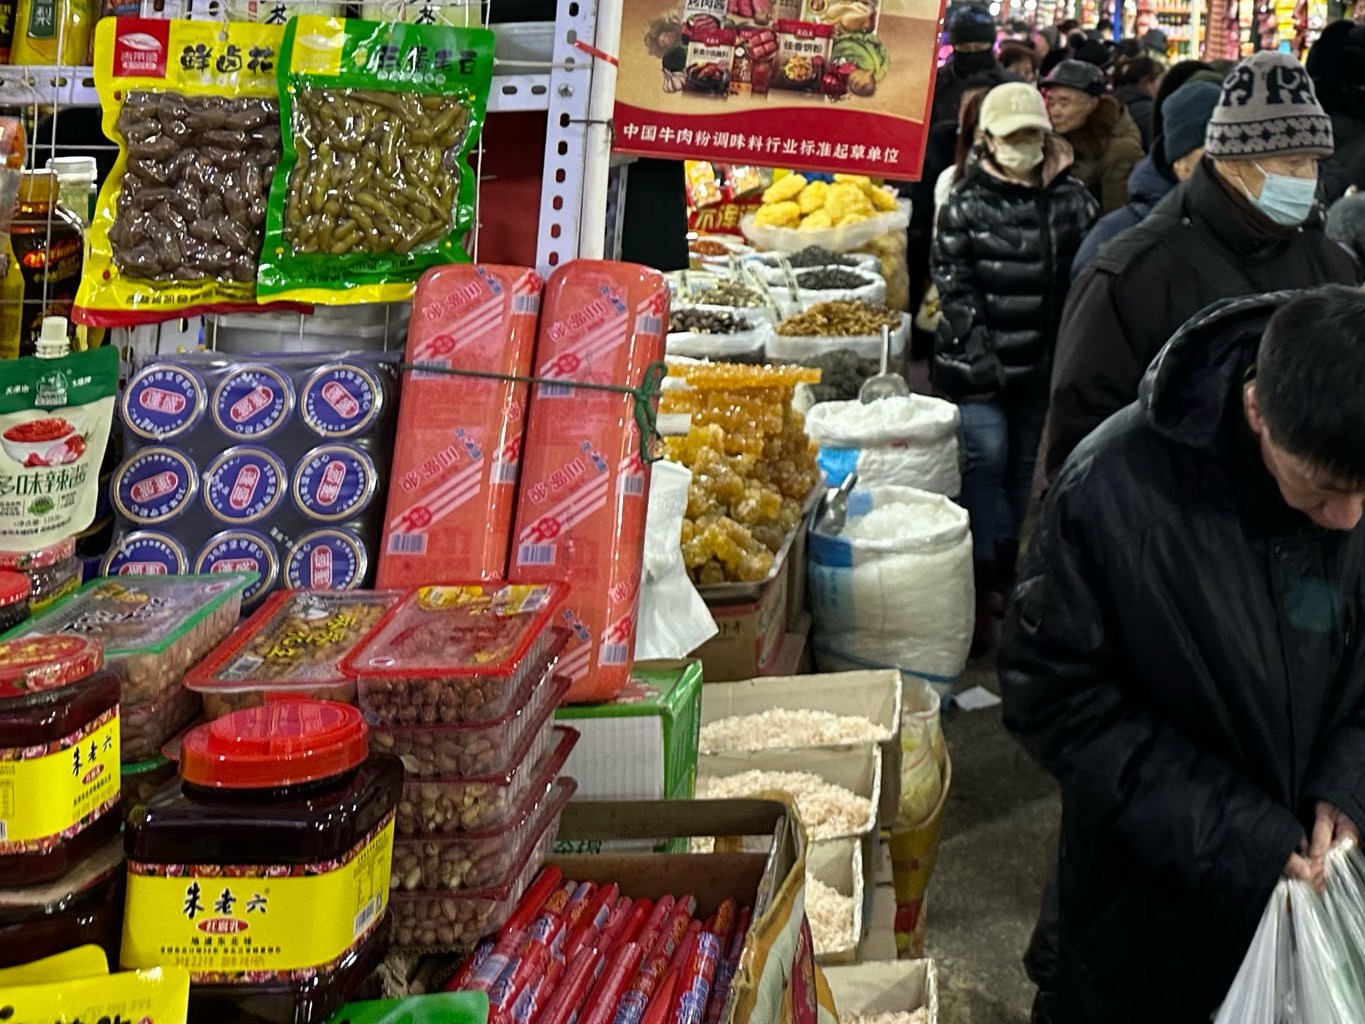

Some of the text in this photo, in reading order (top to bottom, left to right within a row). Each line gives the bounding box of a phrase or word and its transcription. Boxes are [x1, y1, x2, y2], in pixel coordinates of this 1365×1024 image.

[622, 122, 900, 164] 中国牛肉粉调味料行业标准起草单位
[72, 733, 113, 777] 朱老六
[183, 880, 268, 919] 朱老六
